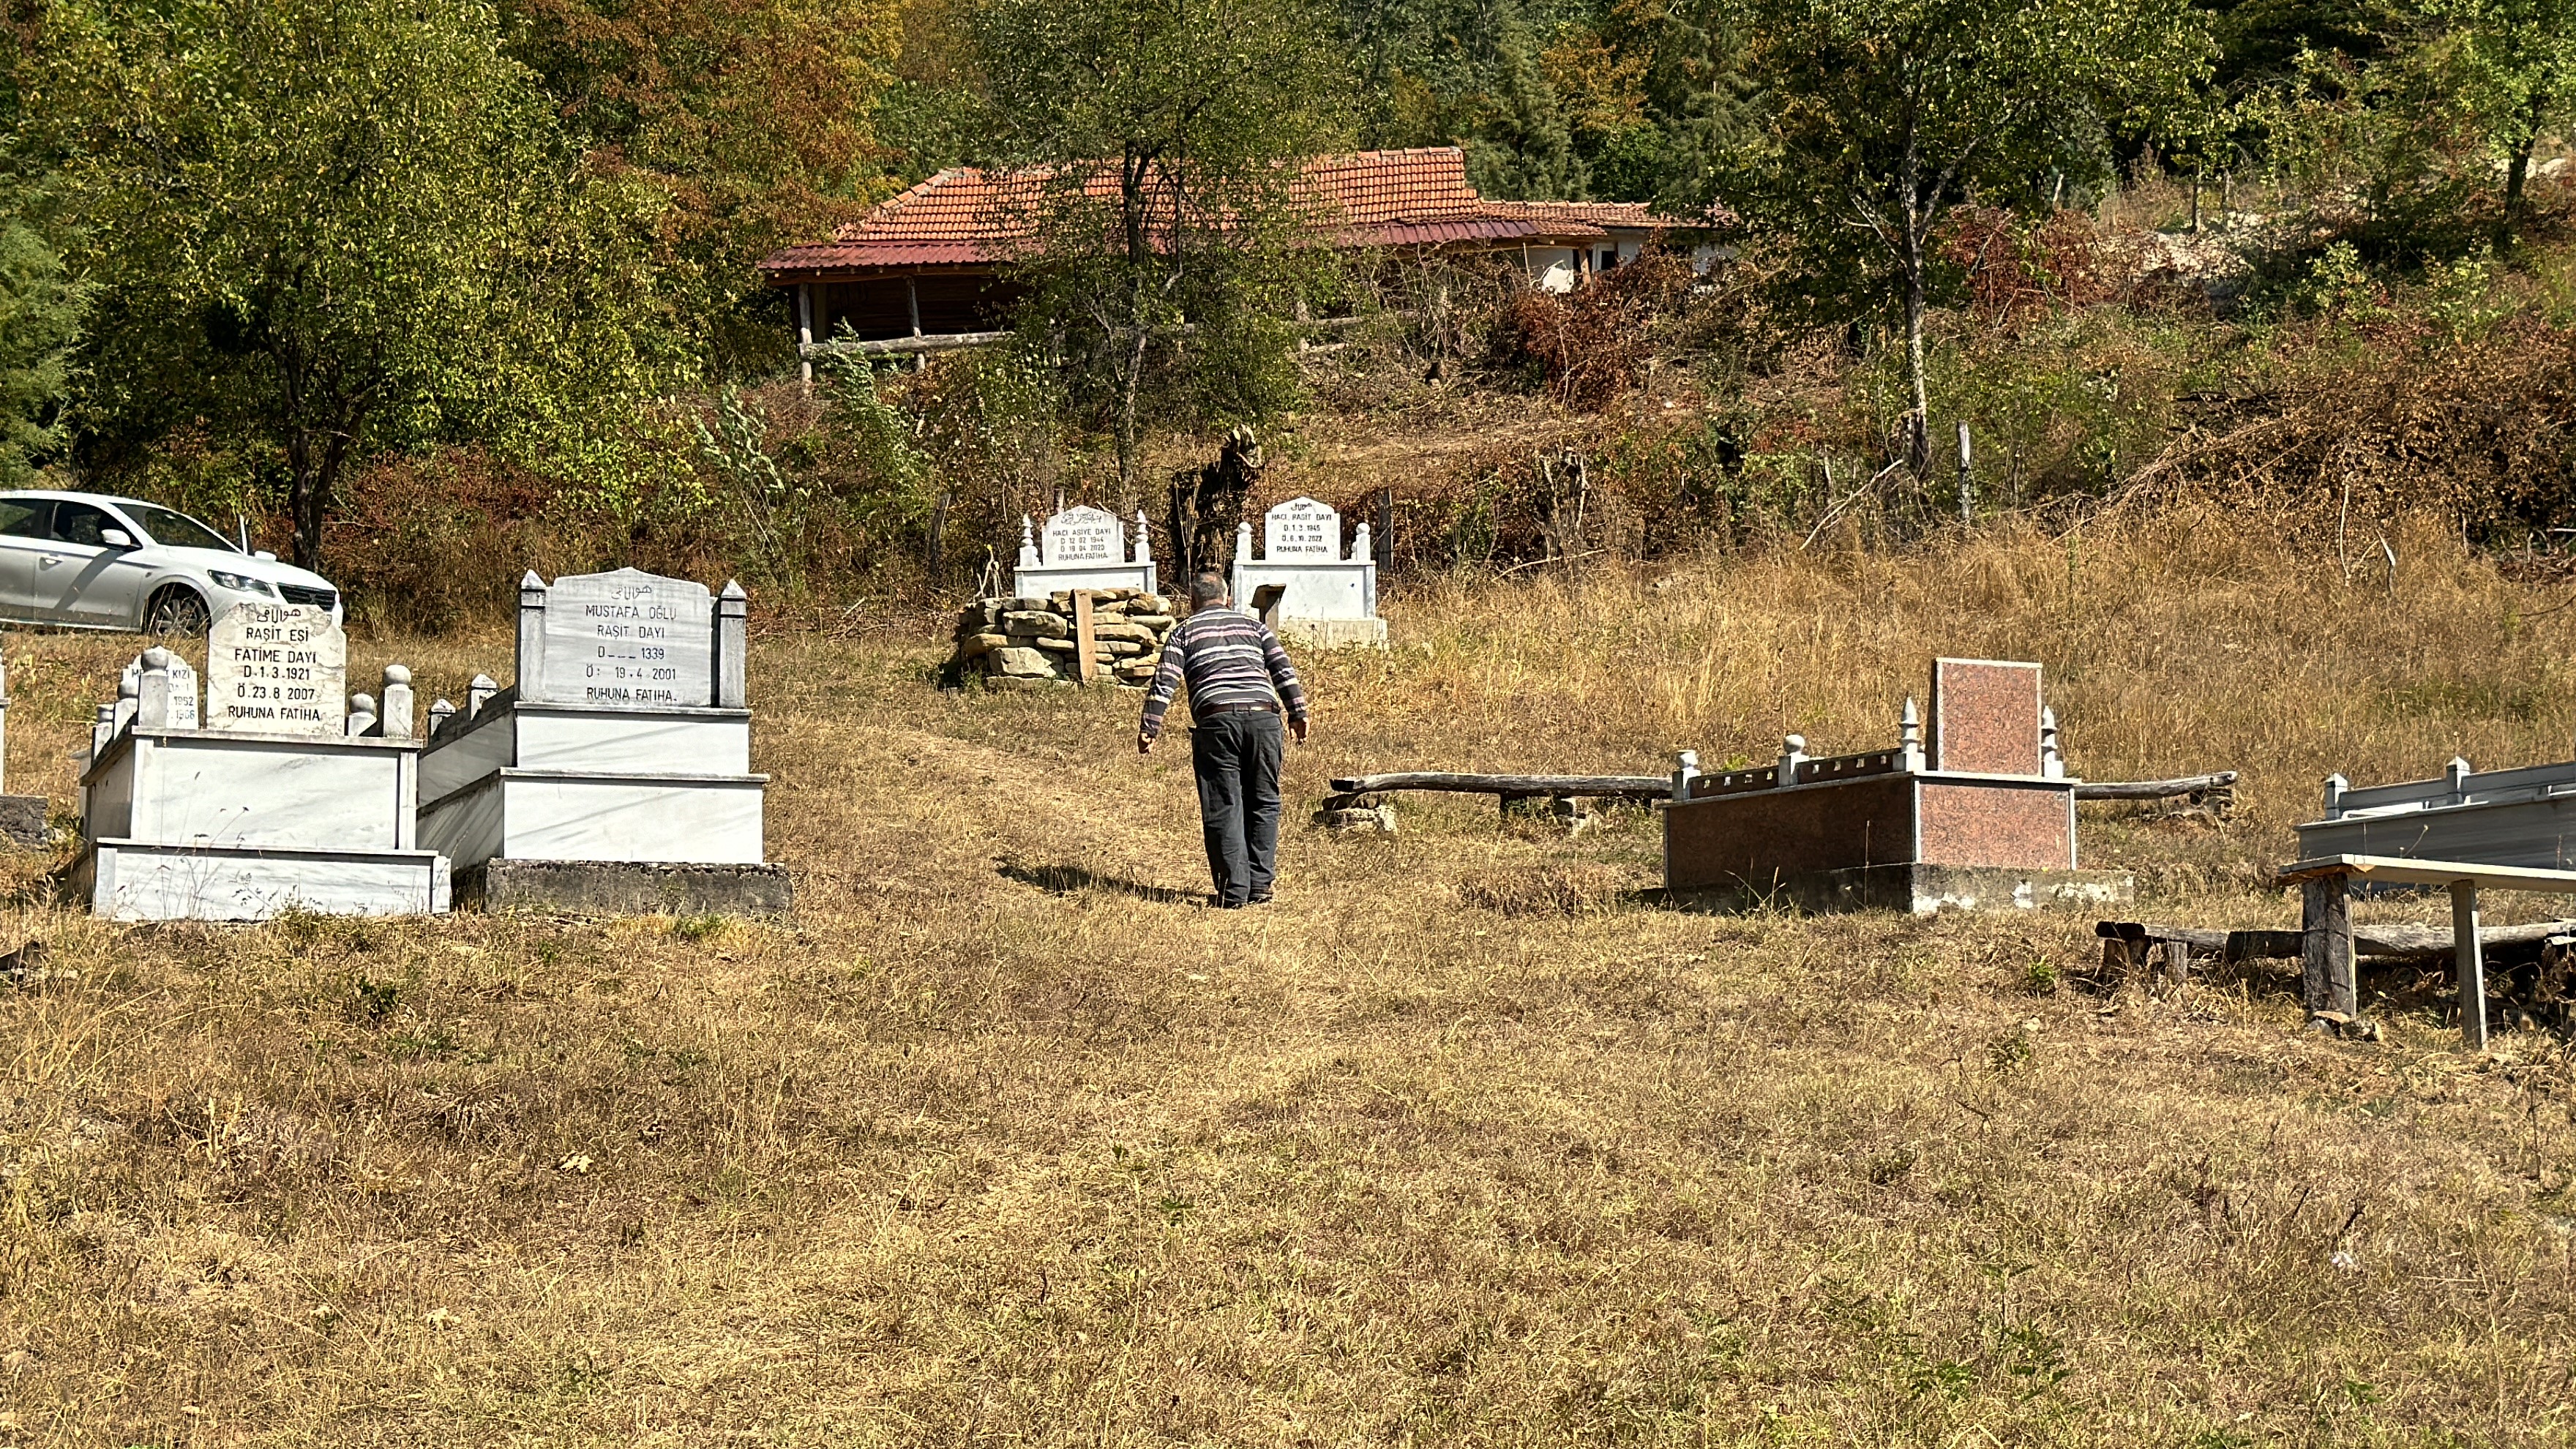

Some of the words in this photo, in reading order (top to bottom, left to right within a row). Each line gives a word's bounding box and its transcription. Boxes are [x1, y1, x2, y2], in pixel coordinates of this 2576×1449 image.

[585, 605, 640, 618] MUSTAFA
[649, 605, 677, 620] OĞLU
[246, 625, 281, 642] RAŞİT
[290, 626, 309, 643] EŞİ
[597, 624, 629, 640] RAŞİT
[639, 626, 664, 639] DAYI
[235, 647, 280, 663] FATİME
[288, 651, 316, 664] DAYI
[641, 648, 664, 659] 1339
[586, 687, 630, 700] RUHUNA
[228, 705, 274, 719] RUHUNA
[280, 708, 321, 722] FATIHA
